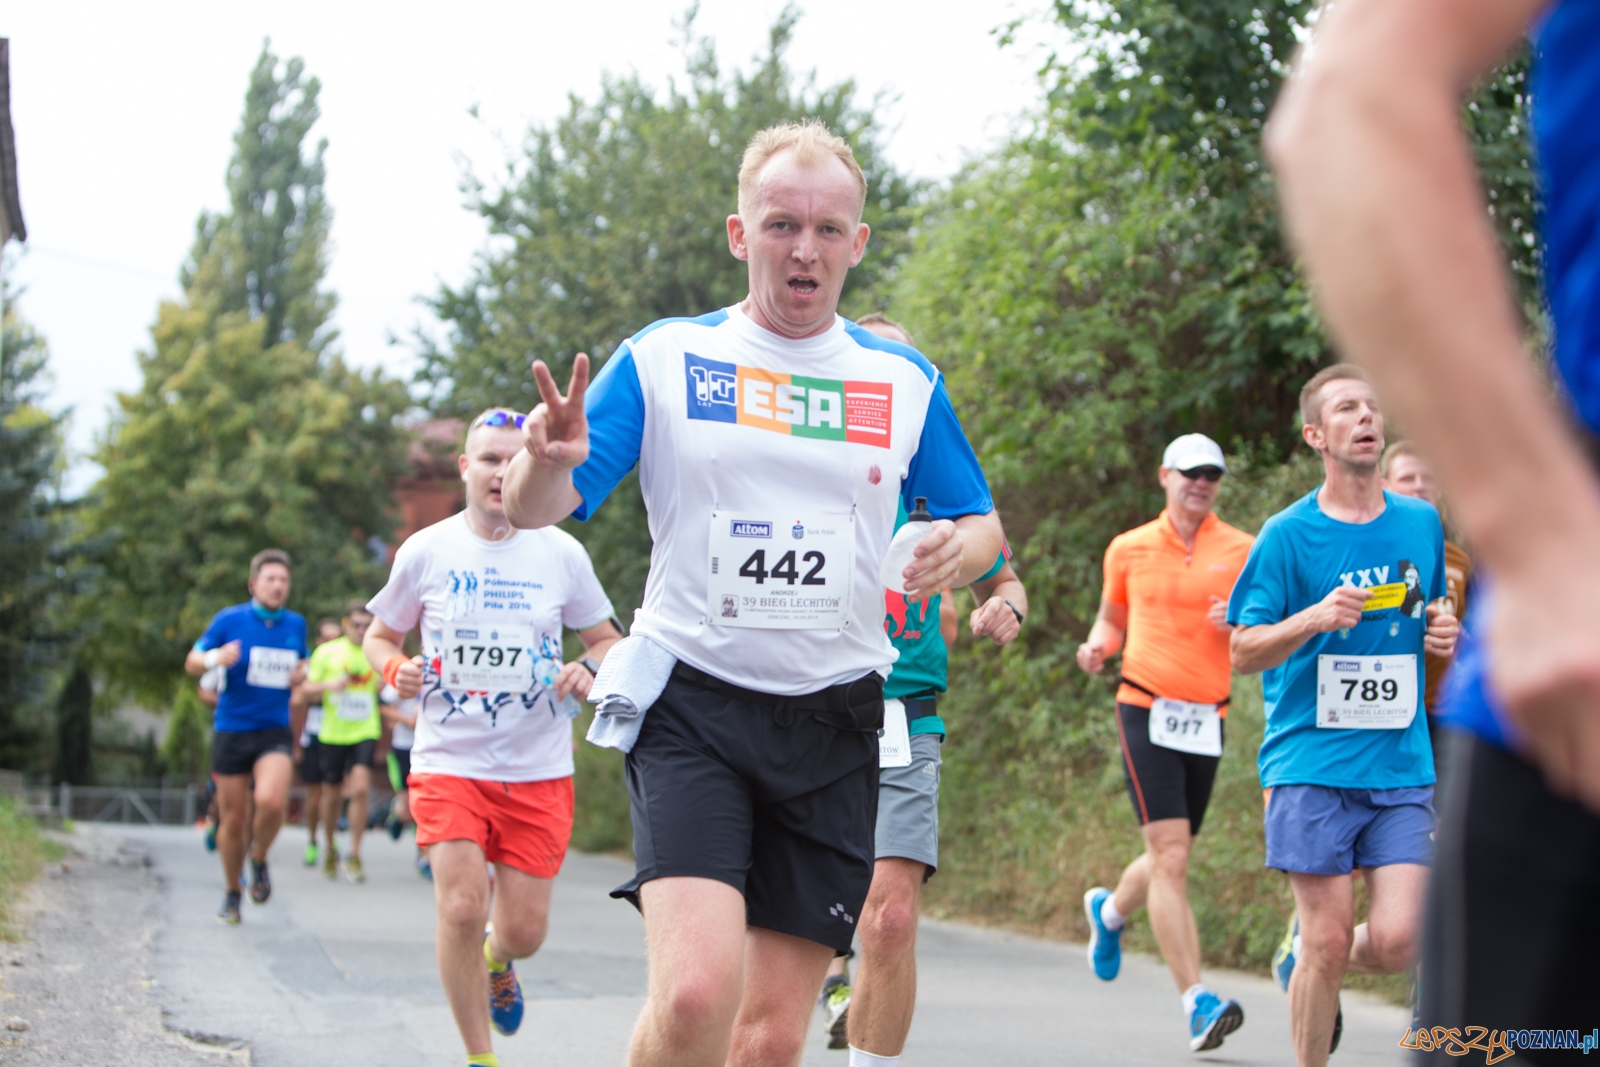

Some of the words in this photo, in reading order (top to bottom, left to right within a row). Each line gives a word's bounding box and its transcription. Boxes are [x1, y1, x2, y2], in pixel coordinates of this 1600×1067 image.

[697, 400, 712, 408] LAT
[743, 377, 842, 429] ESA
[846, 399, 888, 409] EXPERIENCE
[854, 409, 881, 418] SERVICE
[848, 418, 887, 428] ATTENTION
[485, 567, 500, 575] 26.
[739, 549, 826, 586] 442
[1340, 565, 1389, 588] XXV
[484, 590, 524, 599] PHILIPS
[508, 602, 531, 610] 2016
[742, 597, 757, 608] 39
[760, 597, 787, 607] BIEG
[790, 596, 841, 608] LECHITÓW
[453, 645, 522, 667] 1797
[1341, 679, 1398, 702] 789
[1166, 716, 1203, 735] 917
